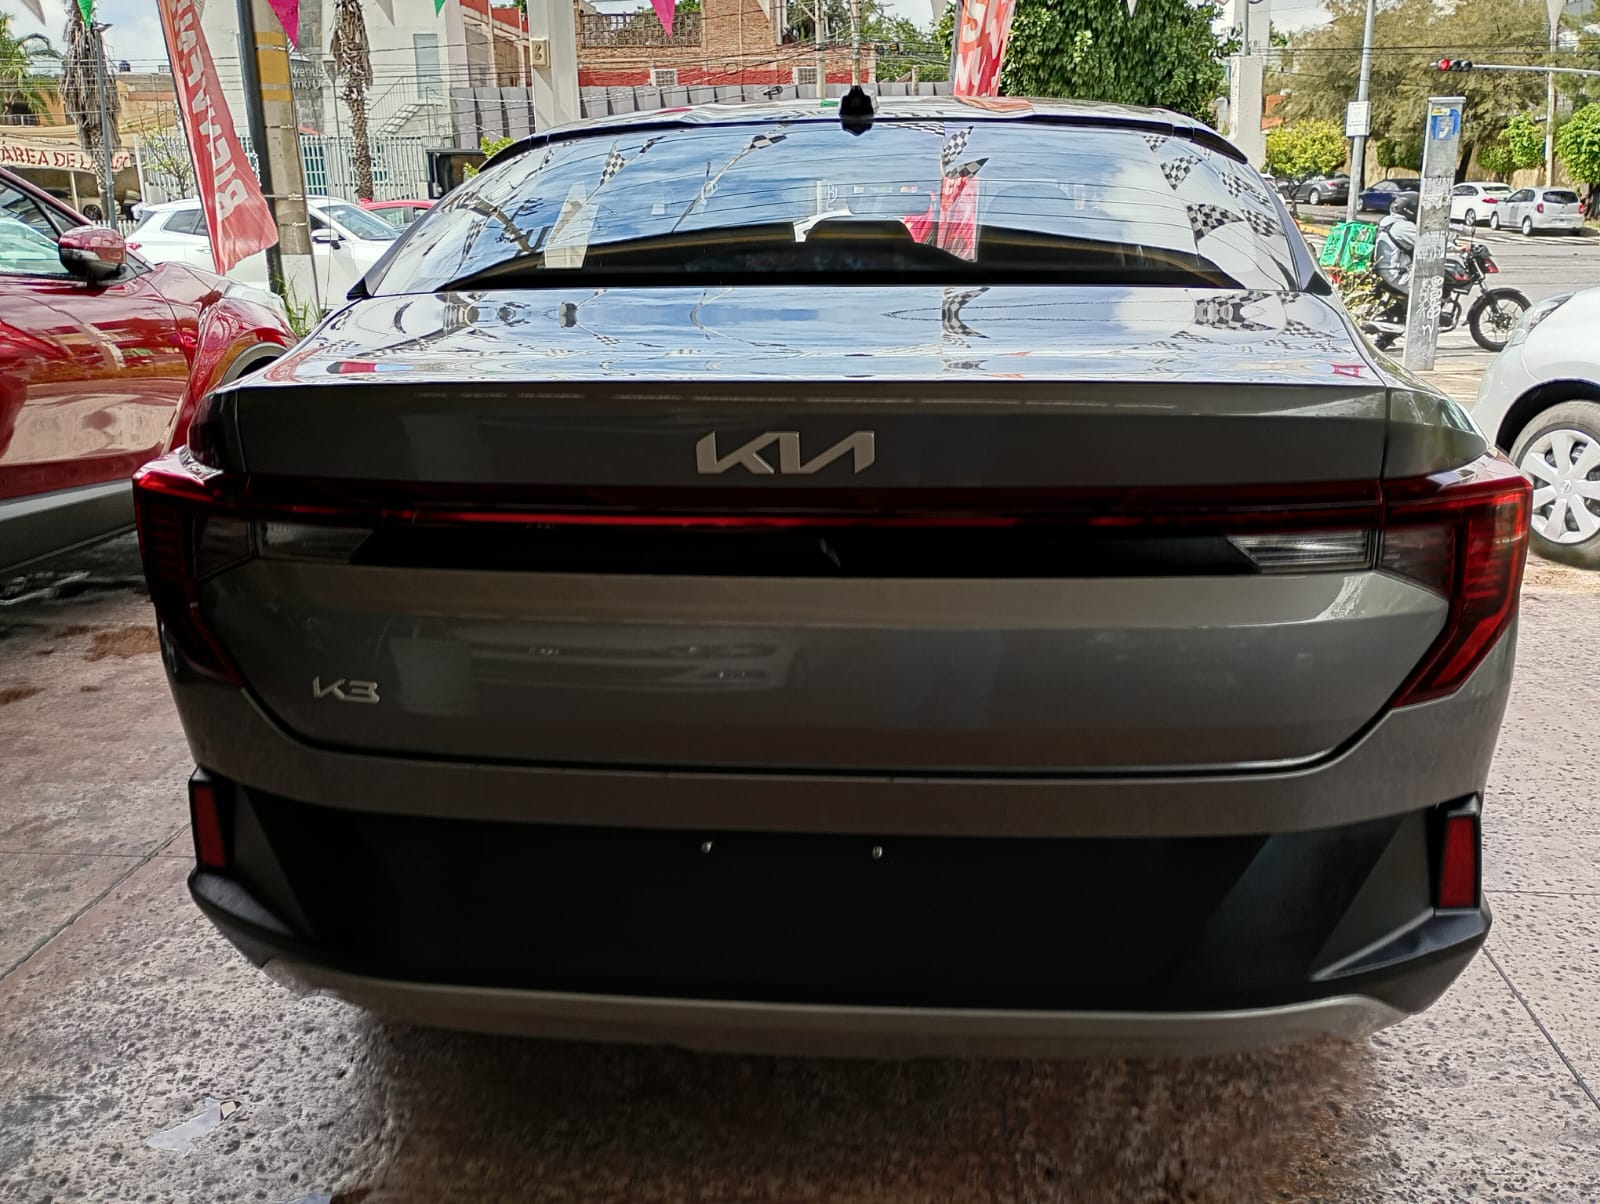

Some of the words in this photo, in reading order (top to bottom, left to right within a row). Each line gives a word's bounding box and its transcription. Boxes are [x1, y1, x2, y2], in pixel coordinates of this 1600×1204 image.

[53, 151, 75, 168] DE
[696, 430, 875, 475] KIA
[312, 675, 380, 704] K3
